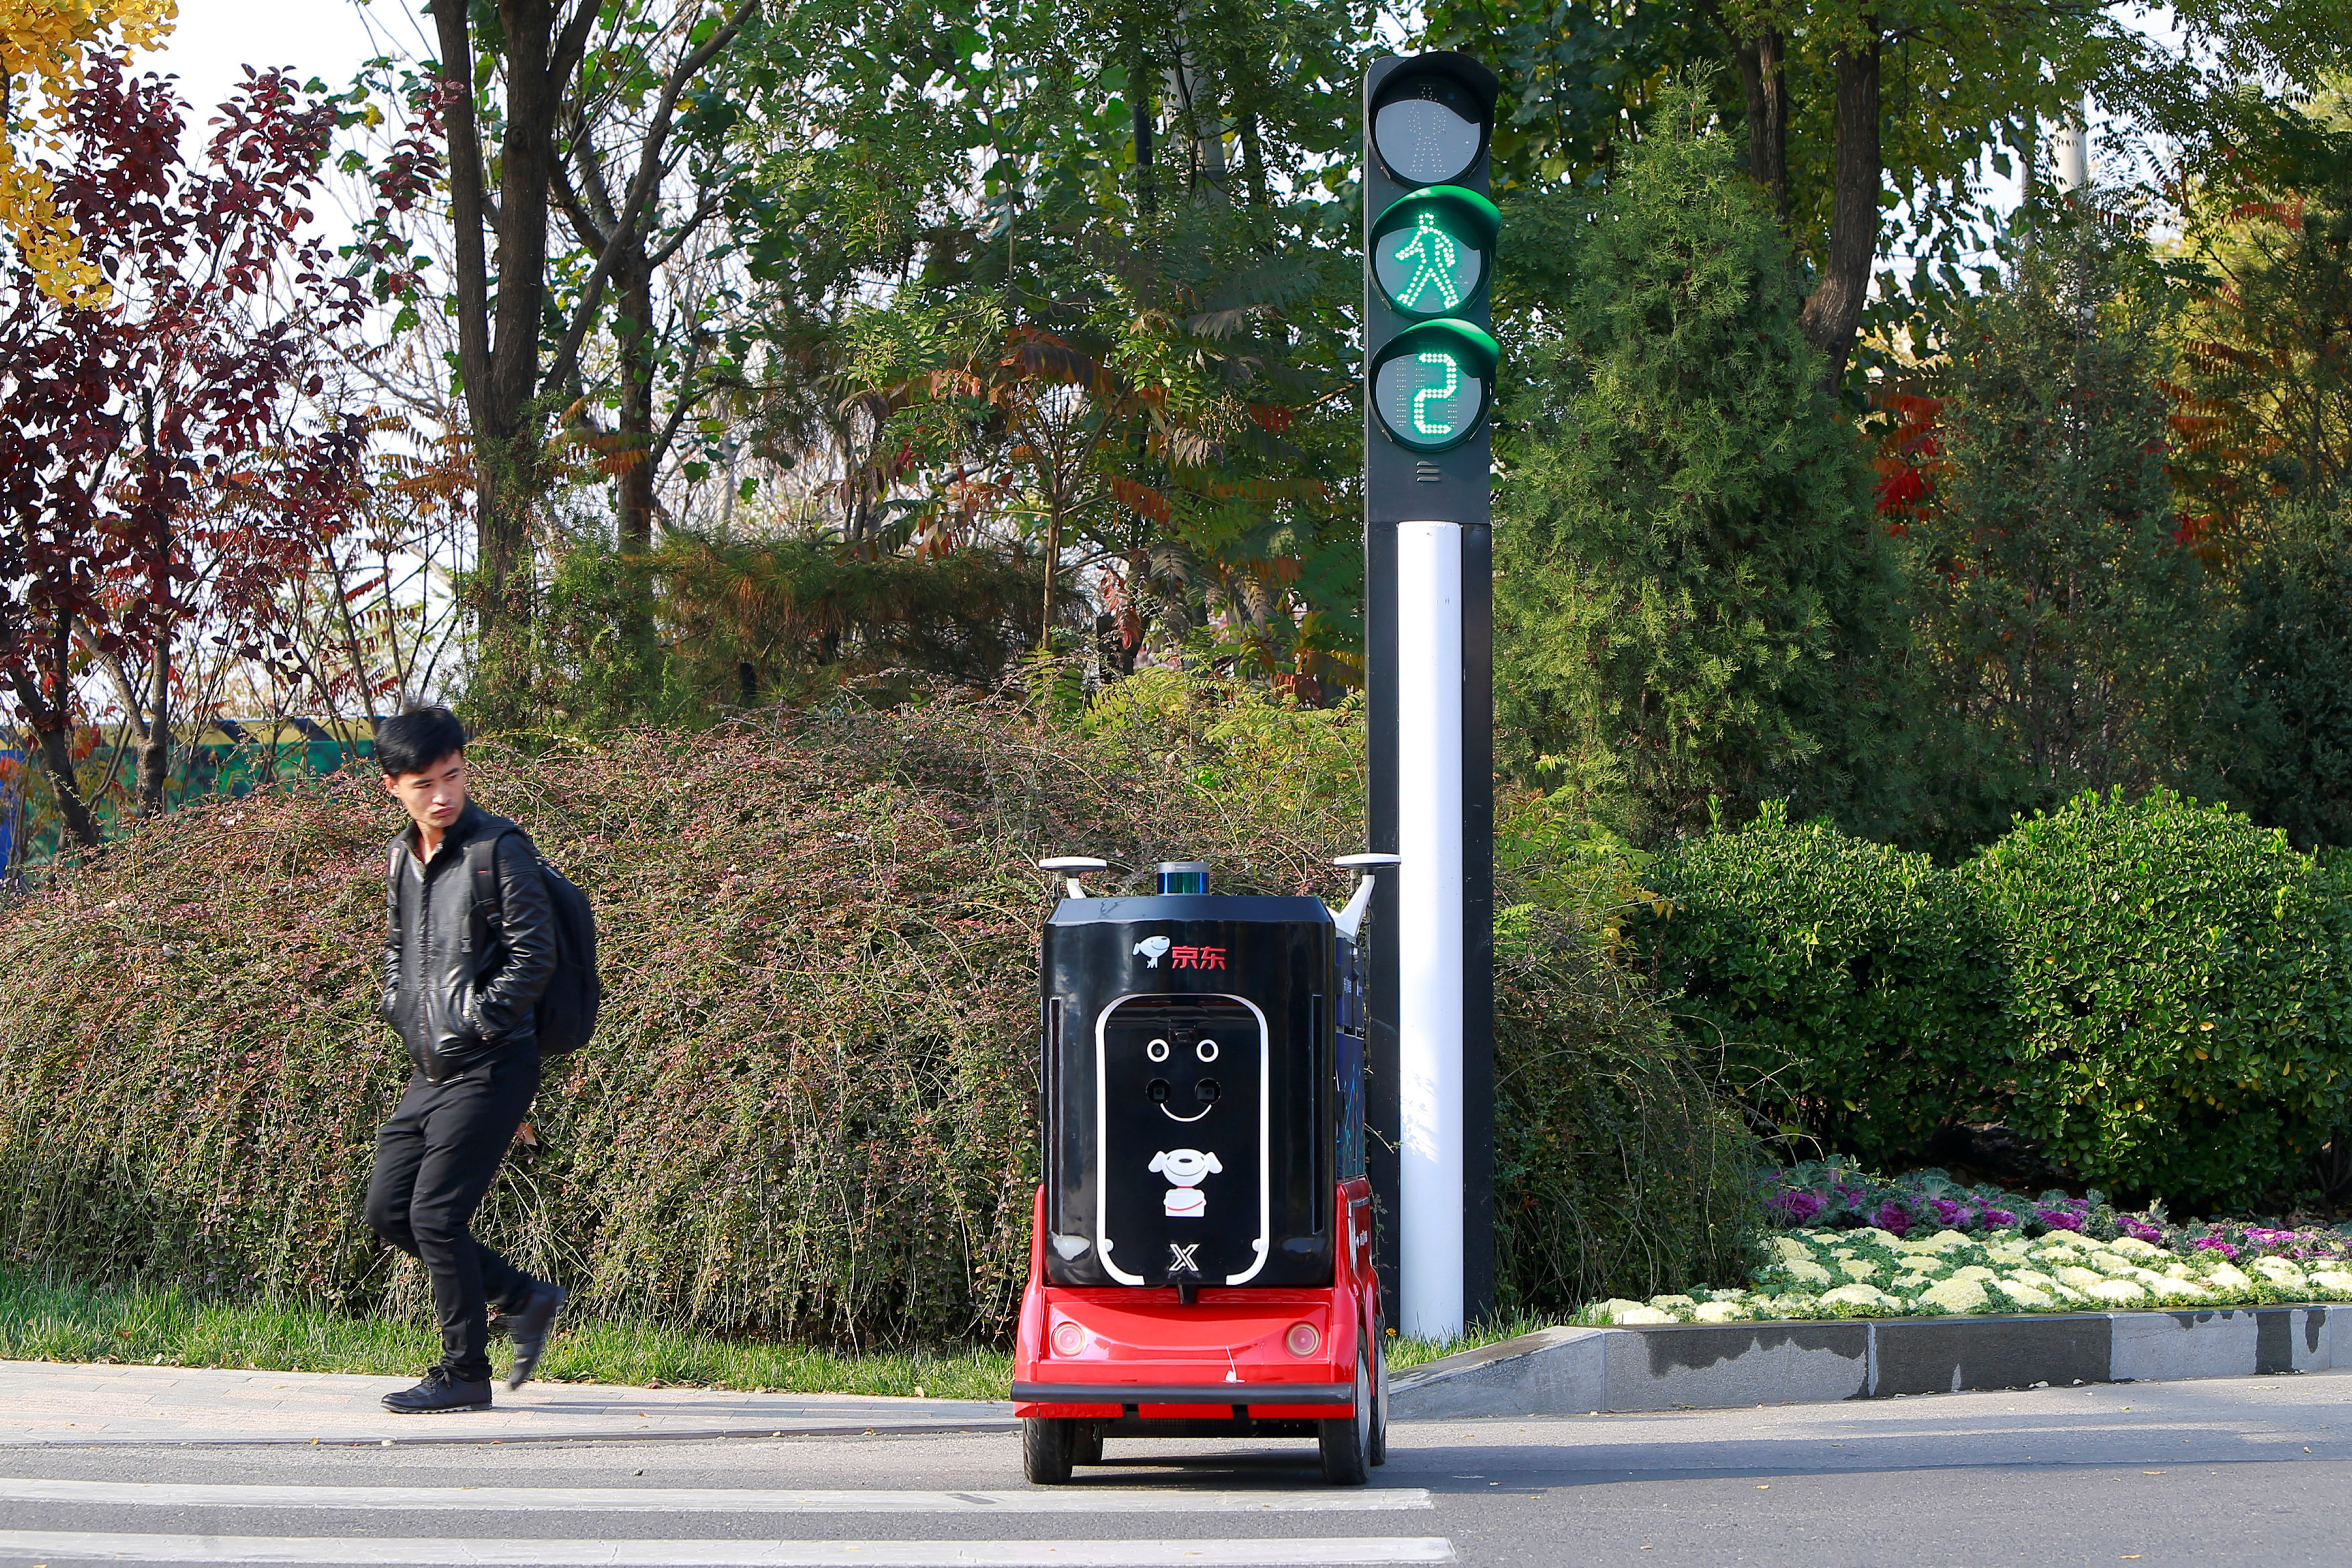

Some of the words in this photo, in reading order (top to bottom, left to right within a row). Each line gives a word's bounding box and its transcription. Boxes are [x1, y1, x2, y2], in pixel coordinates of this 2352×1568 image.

[1414, 353, 1457, 434] 2
[1171, 945, 1226, 971] 京东
[1169, 1243, 1200, 1272] X
